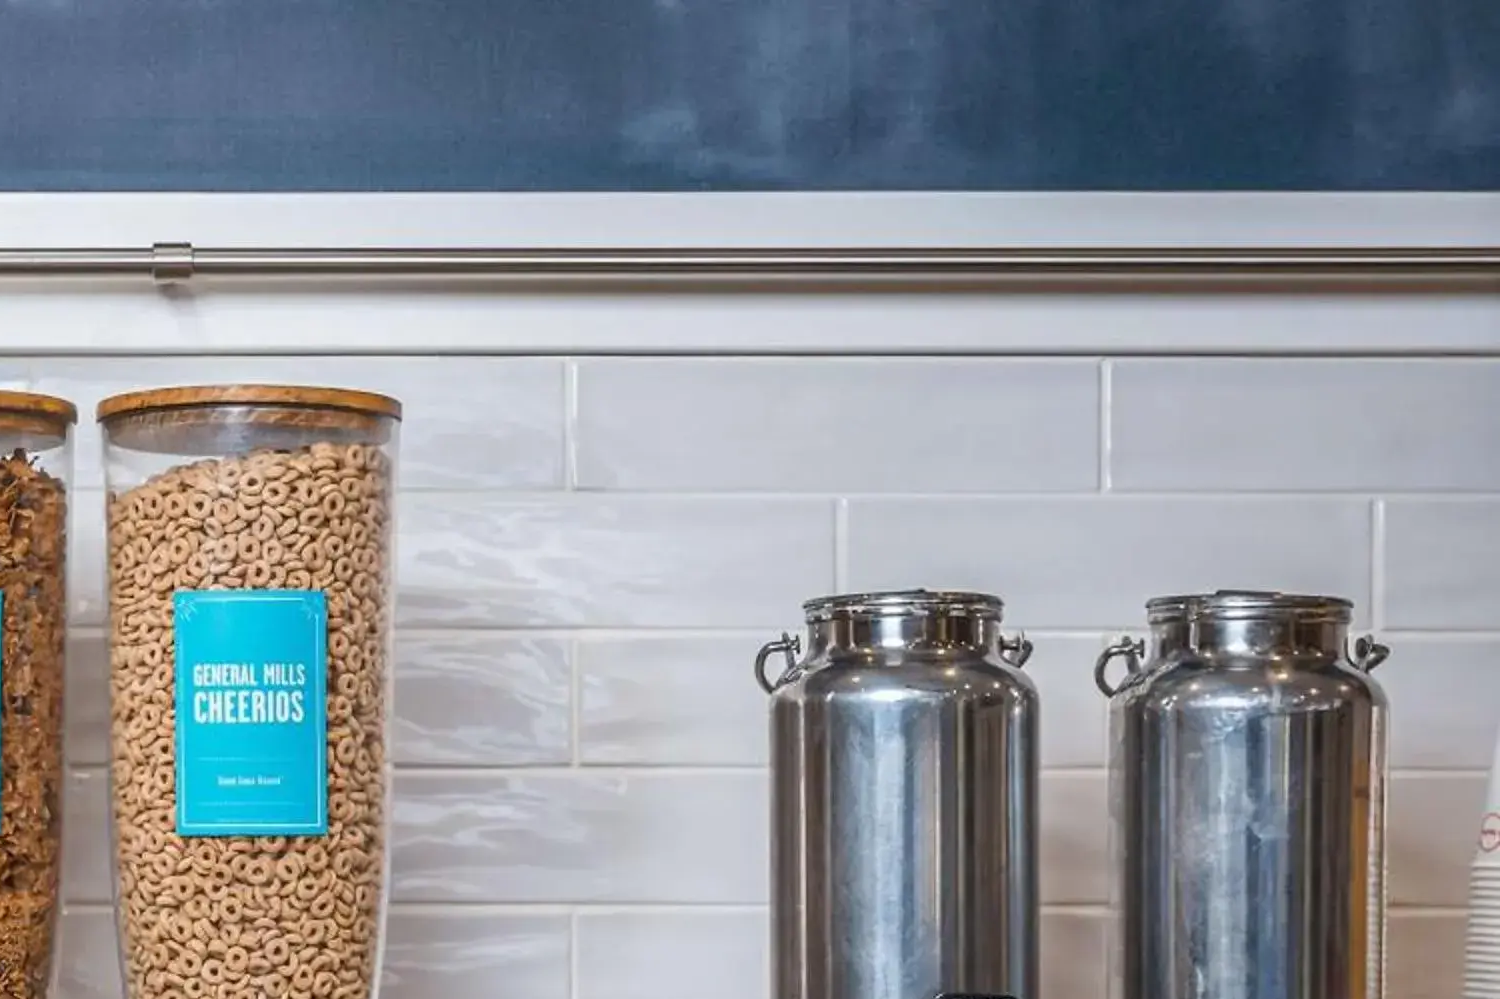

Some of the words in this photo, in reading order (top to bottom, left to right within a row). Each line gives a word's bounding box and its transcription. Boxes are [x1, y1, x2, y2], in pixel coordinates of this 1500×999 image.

[193, 663, 258, 686] GENERAL
[263, 663, 306, 686] MILLS
[193, 690, 305, 724] CHEERIOS
